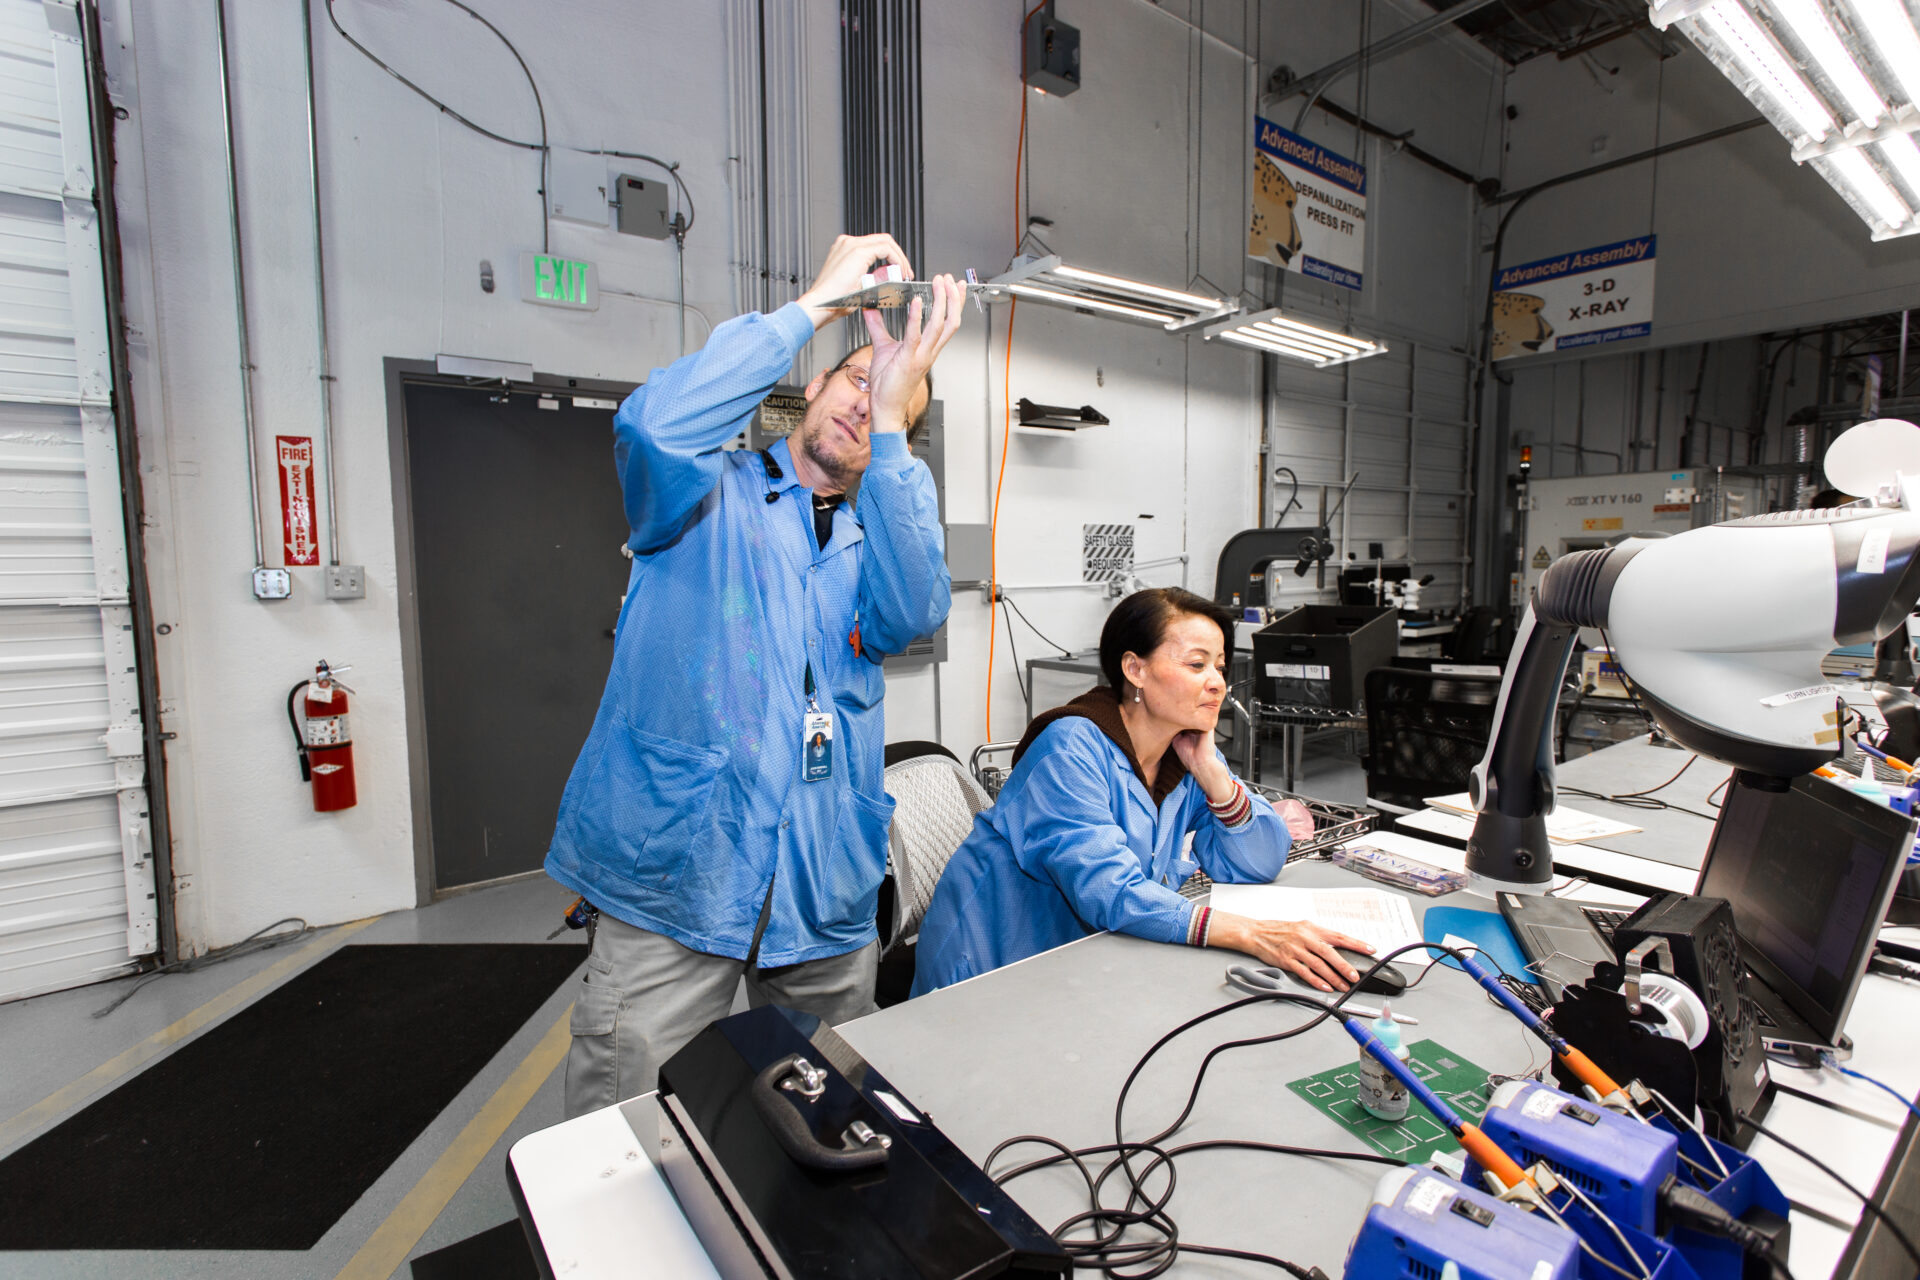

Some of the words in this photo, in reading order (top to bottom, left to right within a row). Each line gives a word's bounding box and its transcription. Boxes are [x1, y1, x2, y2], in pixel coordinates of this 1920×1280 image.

[1261, 124, 1315, 165] Advanced
[1316, 151, 1364, 190] Assembly
[1307, 206, 1338, 230] PRESS
[1341, 220, 1354, 236] FIT
[1500, 256, 1569, 285] Advanced
[1571, 241, 1649, 269] Assembly
[534, 255, 588, 304] EXIT
[1583, 278, 1616, 297] 3-D
[1568, 297, 1630, 321] X-RAY
[1558, 333, 1601, 348] Accelerating
[1602, 331, 1620, 343] your
[765, 396, 806, 409] CAUTION
[282, 447, 308, 461] FIRE
[1591, 496, 1608, 505] XT
[1609, 495, 1618, 504] V
[1621, 494, 1643, 504] 160
[1085, 535, 1107, 547] SAFETY
[1107, 536, 1133, 547] GLASSES
[1785, 689, 1806, 701] TURN
